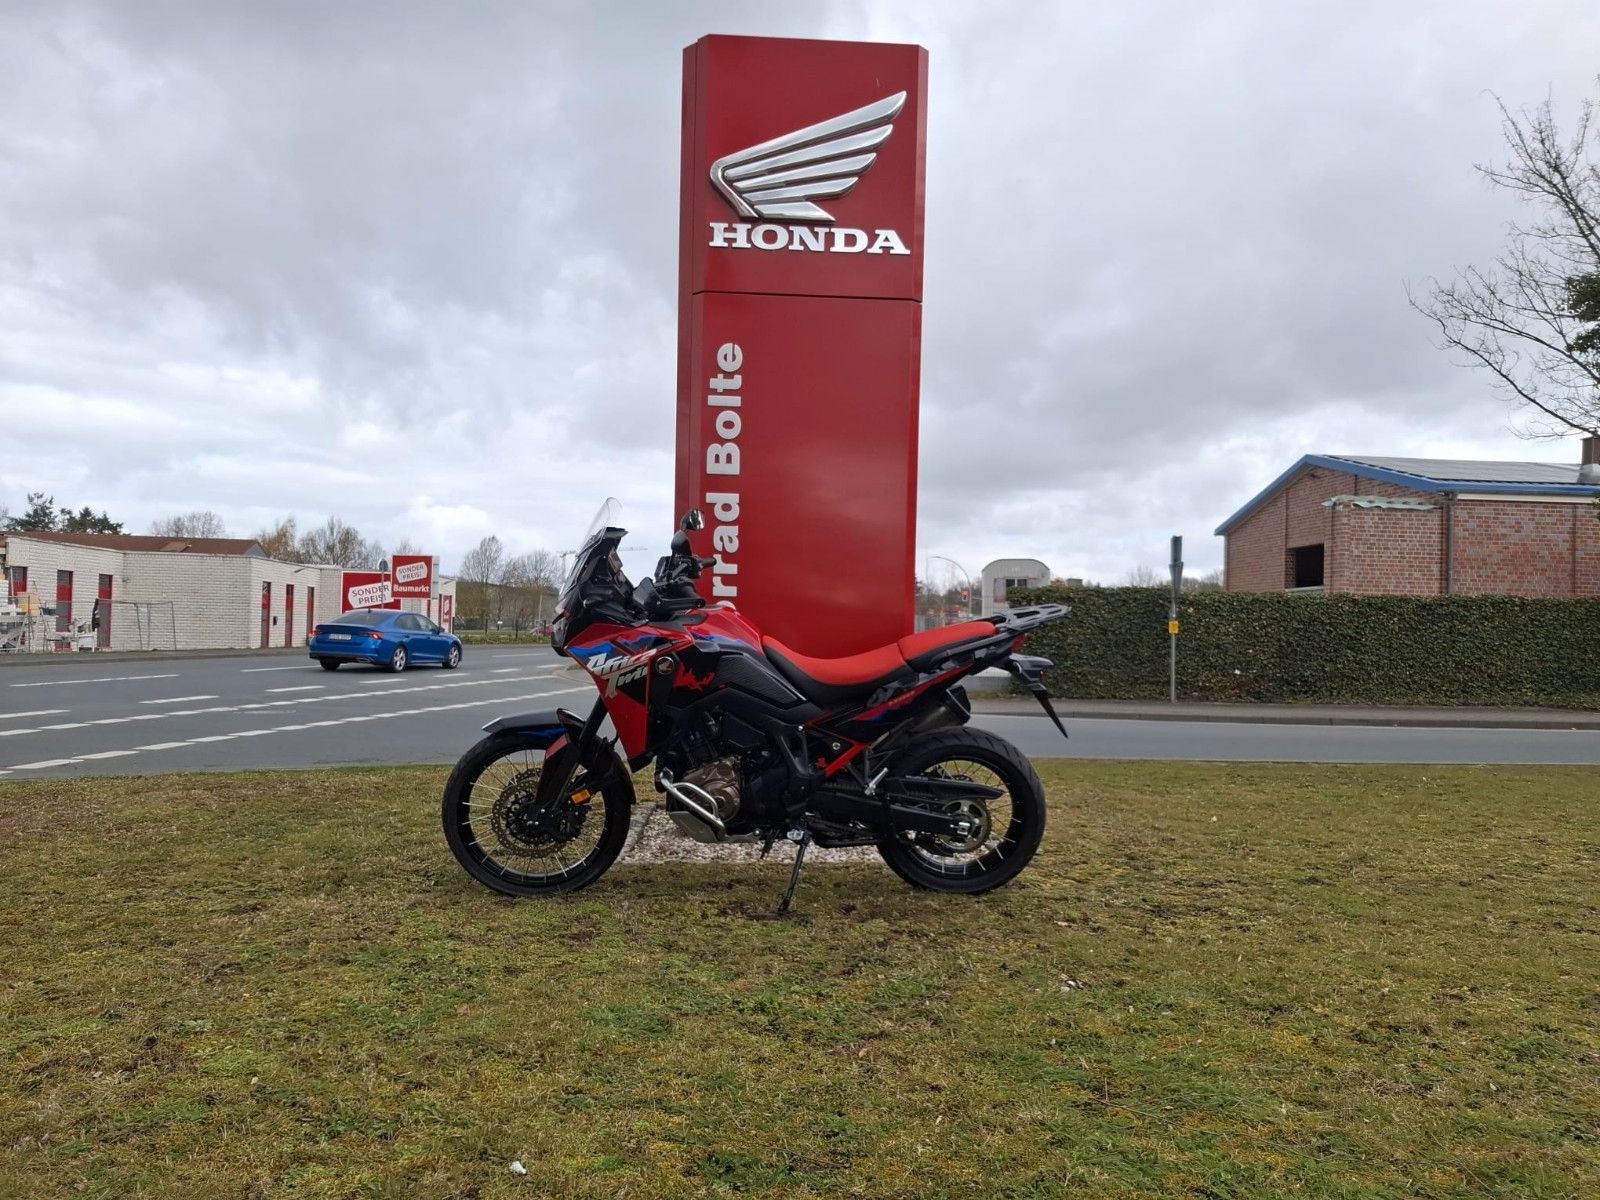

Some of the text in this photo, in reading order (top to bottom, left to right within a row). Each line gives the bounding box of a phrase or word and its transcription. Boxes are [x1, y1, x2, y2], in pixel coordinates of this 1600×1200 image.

[709, 222, 911, 255] HONDA
[706, 342, 743, 475] Bolte
[399, 564, 424, 575] SONDER
[402, 572, 422, 581] PREIS!
[351, 584, 390, 597] SONDER
[393, 584, 430, 593] Baumarkt
[358, 595, 387, 605] PREIS!
